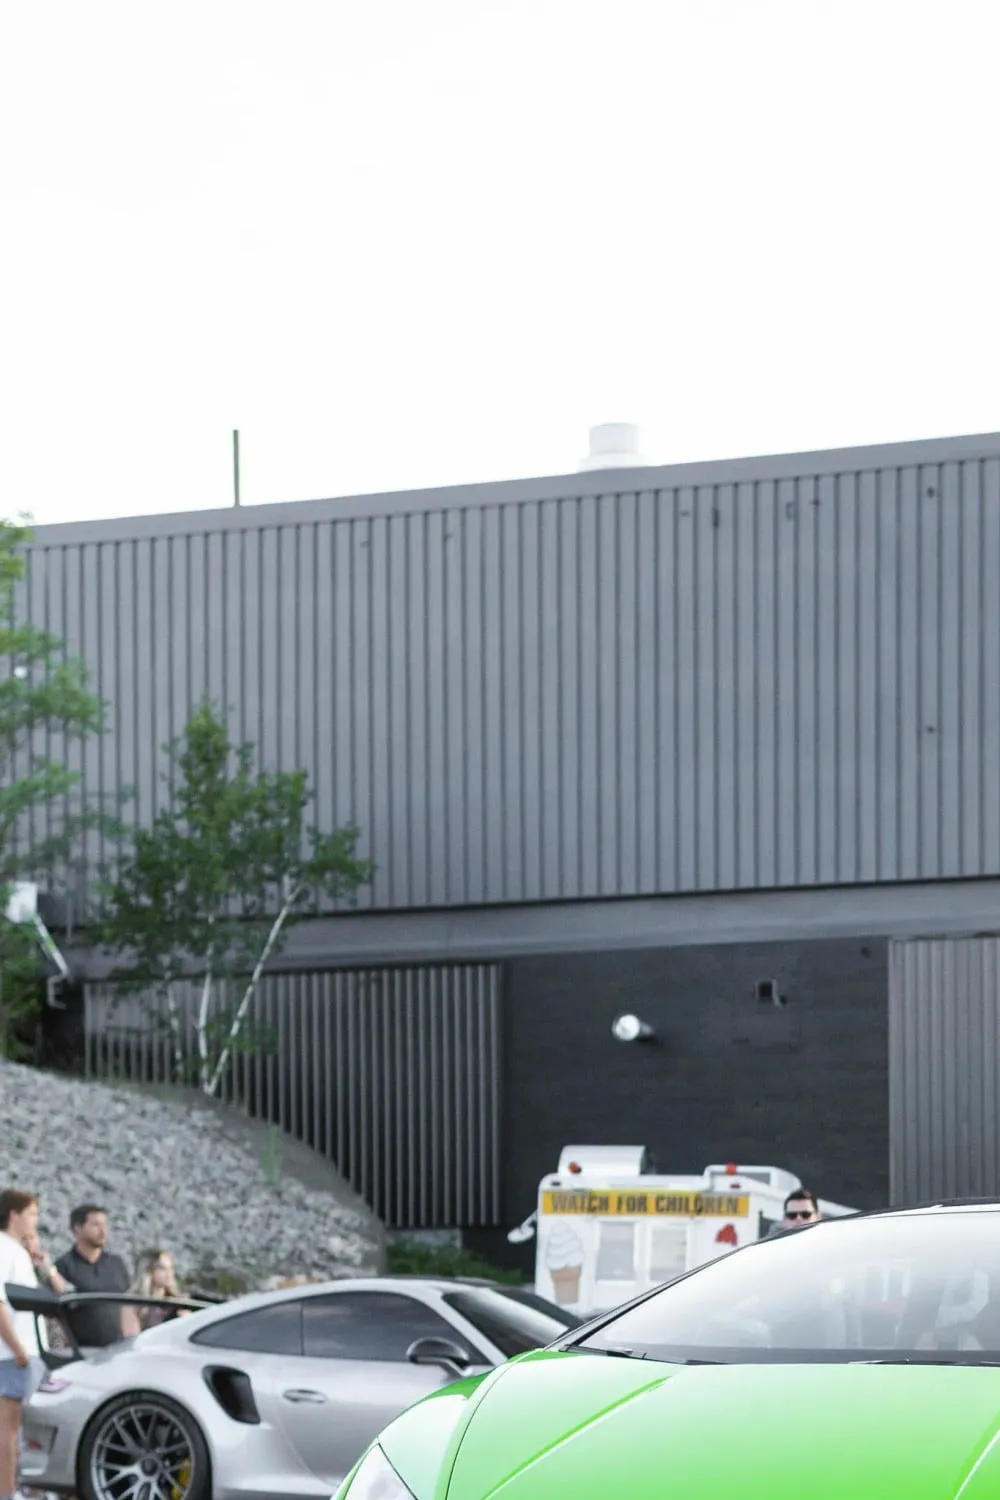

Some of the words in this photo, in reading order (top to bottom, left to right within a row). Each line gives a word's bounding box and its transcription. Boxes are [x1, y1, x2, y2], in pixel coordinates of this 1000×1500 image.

[551, 1193, 610, 1214] WATCH
[617, 1194, 648, 1214] FOR
[655, 1194, 739, 1215] CHILDREN
